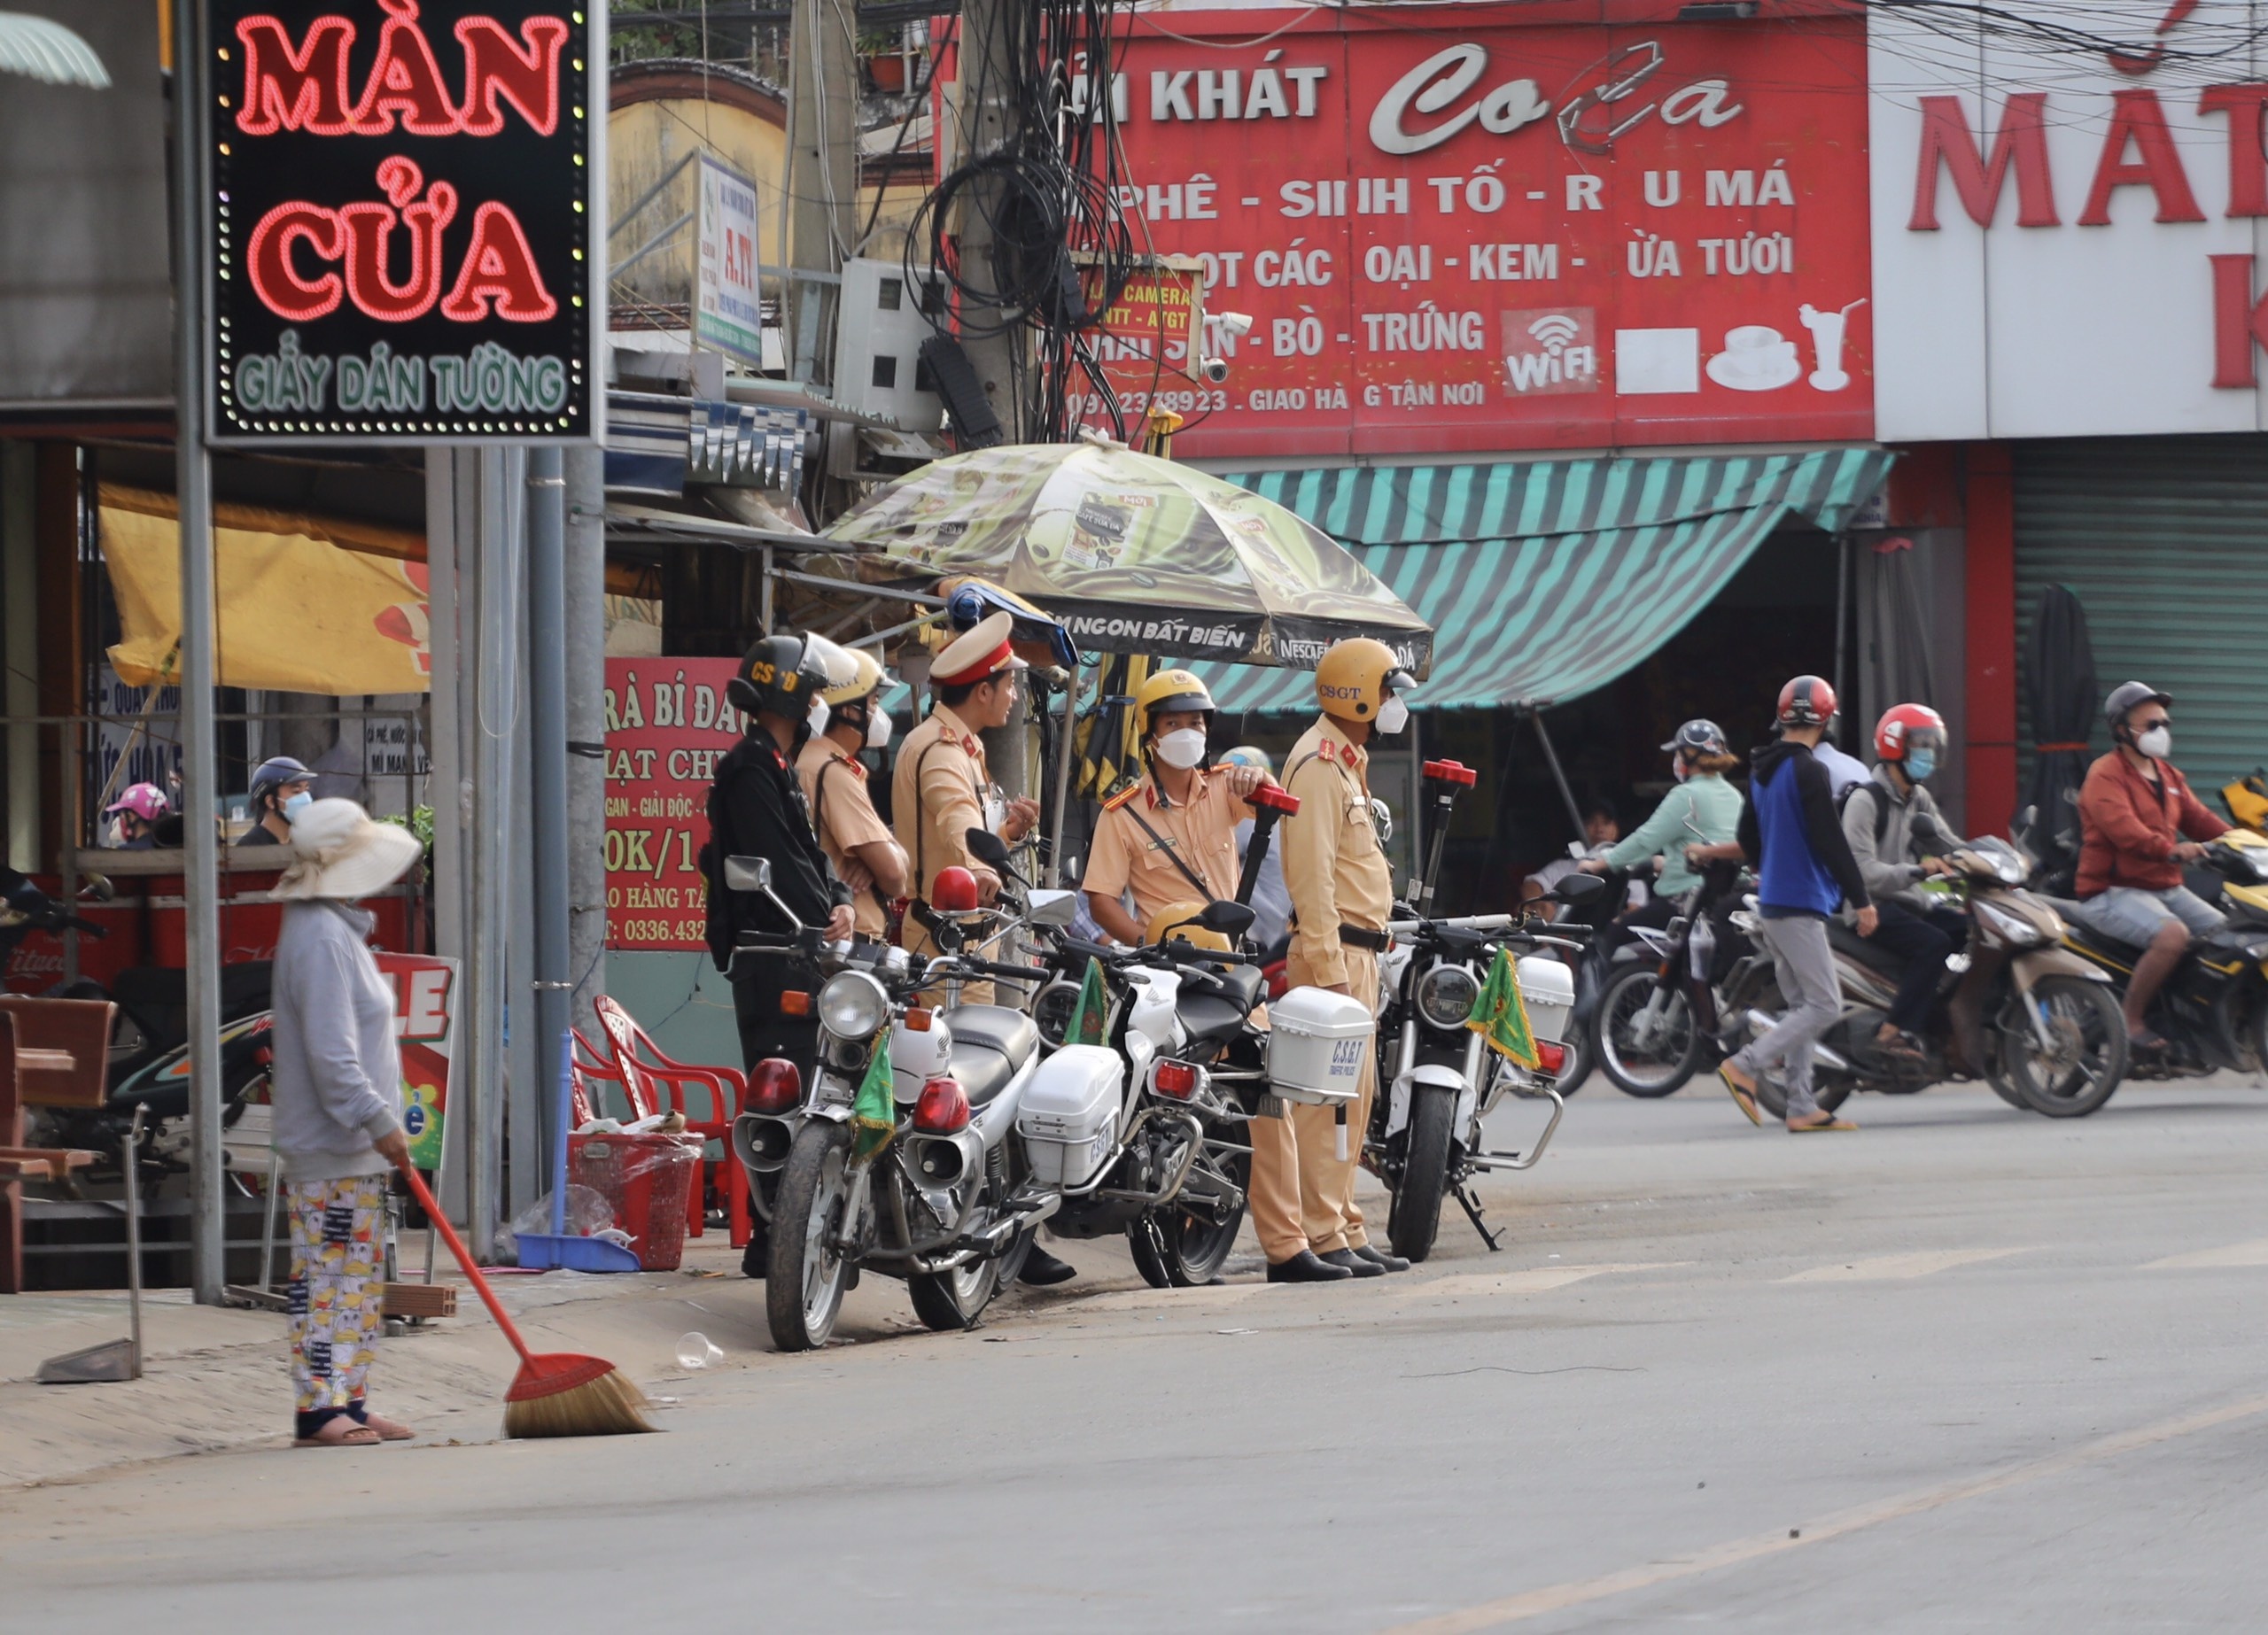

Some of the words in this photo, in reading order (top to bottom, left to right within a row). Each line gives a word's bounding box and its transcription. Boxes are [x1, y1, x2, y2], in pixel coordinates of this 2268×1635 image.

[1151, 50, 1326, 120] KHÁT
[1428, 158, 1504, 214] TỐ
[1705, 159, 1795, 206] MÁ
[247, 156, 557, 322] CỬA
[1254, 237, 1332, 288] CÁC
[1364, 244, 1430, 290] OẠI
[1470, 244, 1557, 281] KEM
[1697, 231, 1794, 276] TƯƠI
[1123, 284, 1191, 306] CAMERA
[1272, 305, 1324, 356] BÒ
[1361, 299, 1485, 354] TRỨNG
[1249, 388, 1306, 411] GIAO
[1388, 379, 1436, 410] TẬN
[1442, 382, 1485, 406] NƠI
[1072, 616, 1142, 638] NGON
[1143, 618, 1188, 642] BẤT
[1189, 624, 1246, 648] BIẾN
[751, 661, 775, 684] CS
[604, 670, 644, 732] RÀ
[653, 669, 686, 728] BÍ
[1319, 685, 1361, 700] CSGT
[604, 797, 629, 818] GAN
[640, 790, 664, 818] GIẢI
[667, 794, 693, 821] ĐỘC
[625, 881, 680, 910] HÀNG
